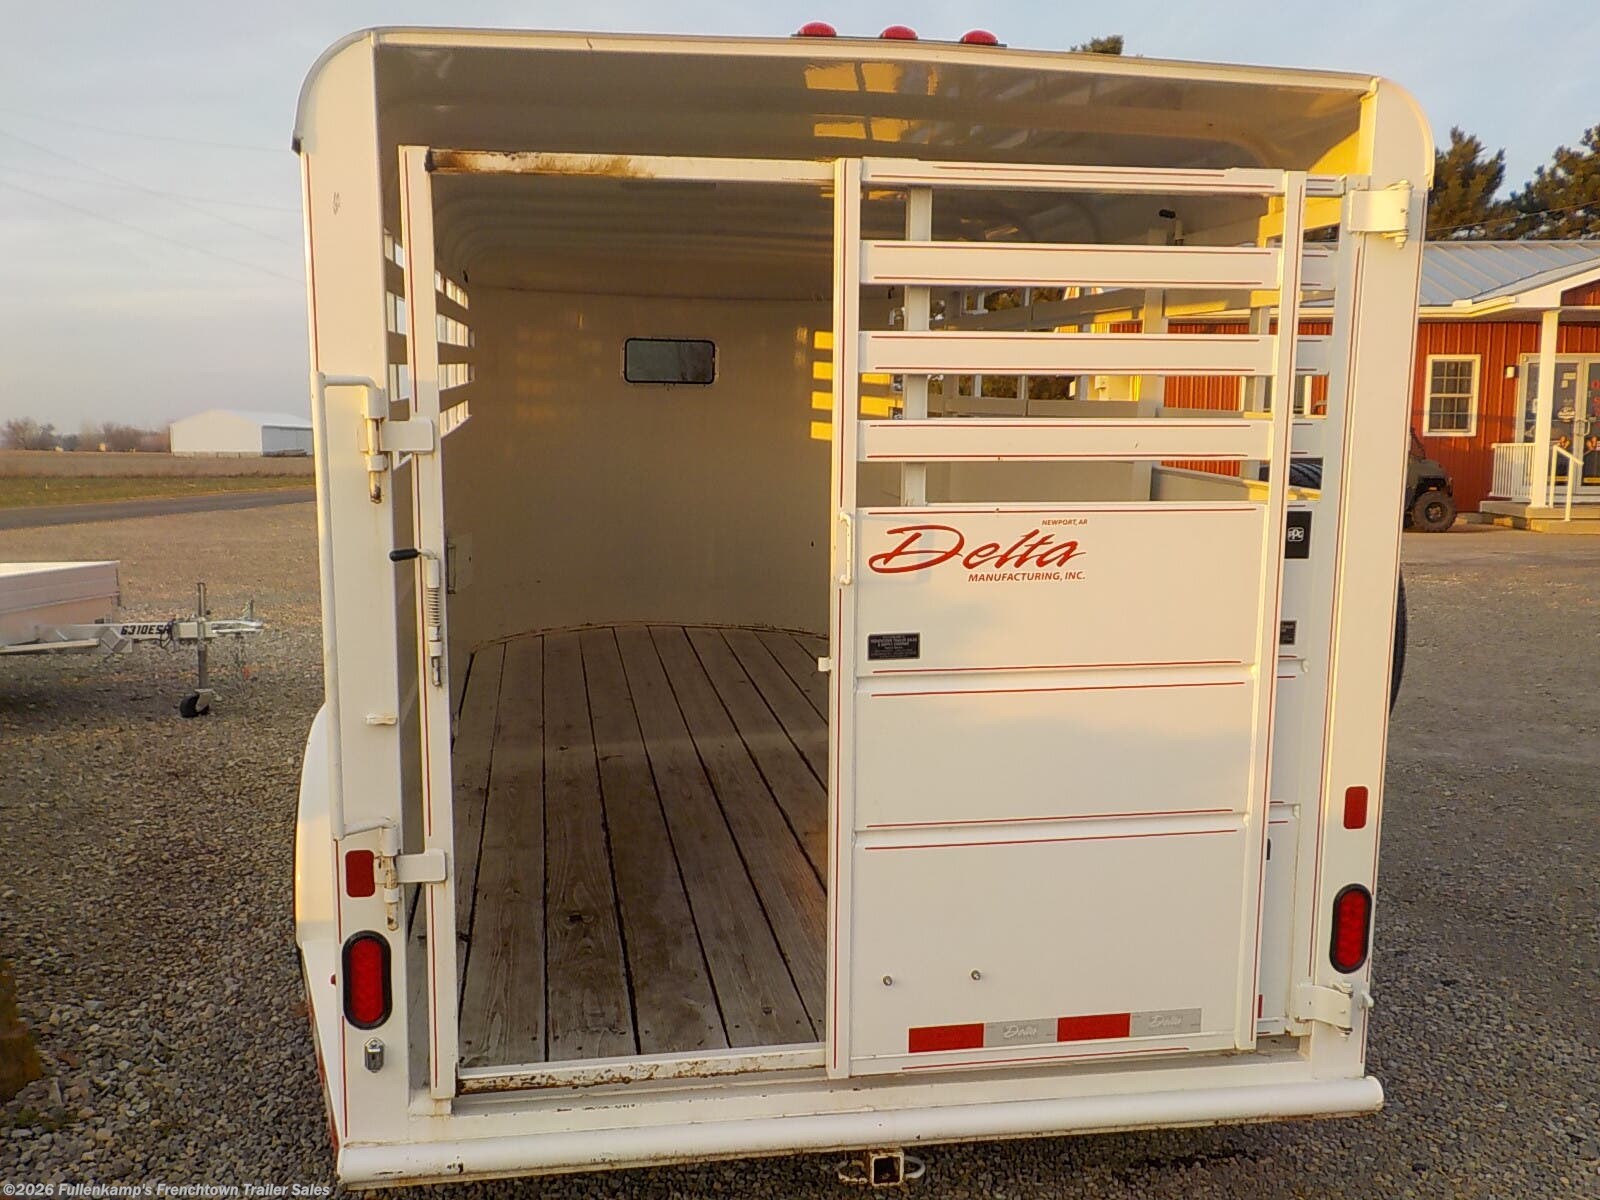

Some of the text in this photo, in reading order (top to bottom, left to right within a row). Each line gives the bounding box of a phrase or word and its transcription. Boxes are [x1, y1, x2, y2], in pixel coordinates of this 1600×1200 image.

[1078, 518, 1088, 526] AR
[868, 525, 1086, 574] Delta
[968, 572, 1086, 583] MANUFACTURING, INC.
